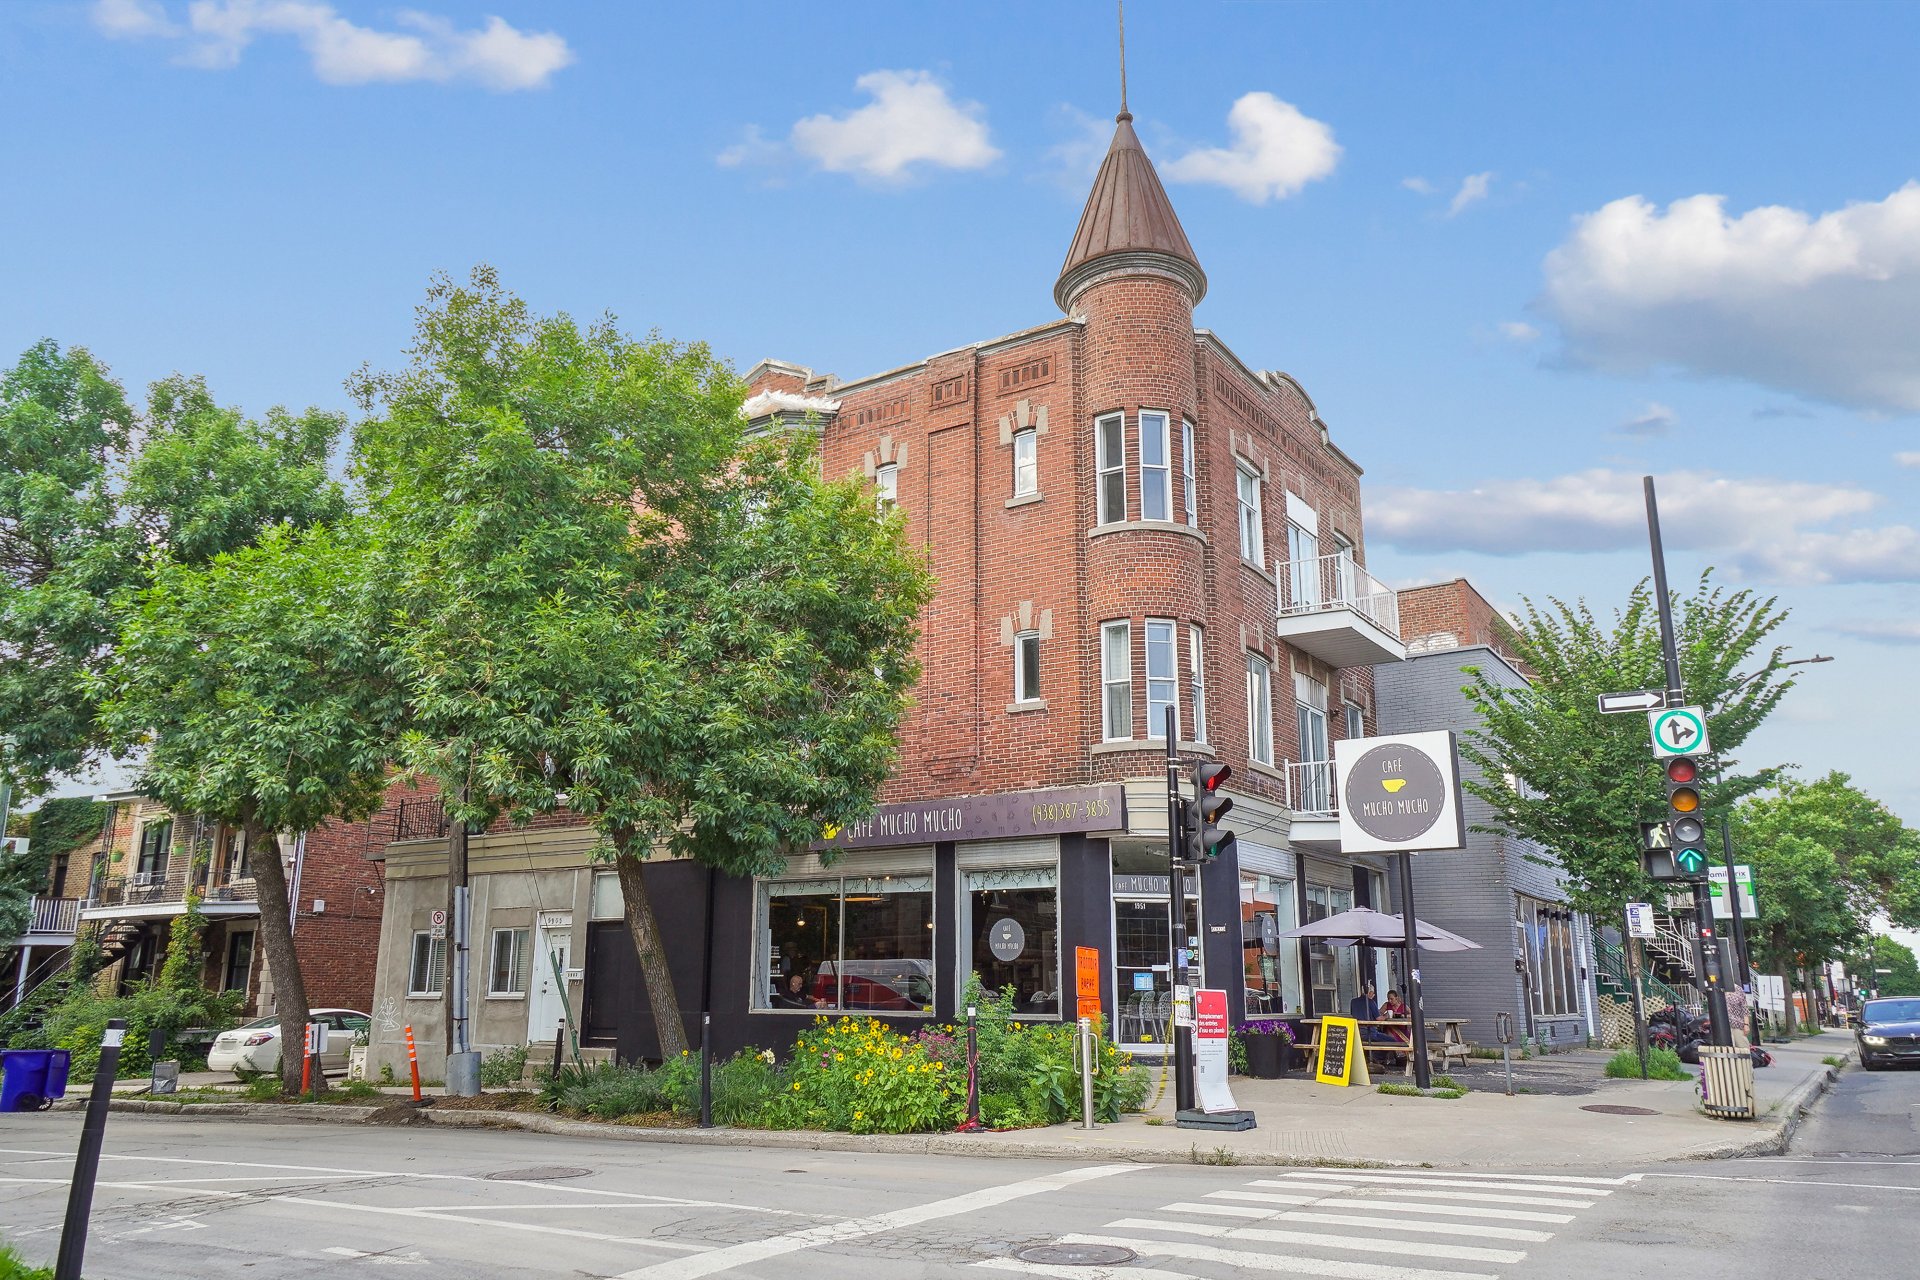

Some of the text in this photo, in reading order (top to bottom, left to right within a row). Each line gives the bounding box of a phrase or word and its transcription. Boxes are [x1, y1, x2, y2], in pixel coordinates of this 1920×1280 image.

[1382, 757, 1402, 773] CAFÉ
[1032, 800, 1110, 825] (438)387-3855
[1363, 798, 1429, 816] MUCHO MUCHO
[880, 811, 917, 836] MUCHO
[923, 808, 962, 833] MUCHO
[1130, 877, 1159, 891] MUCHO
